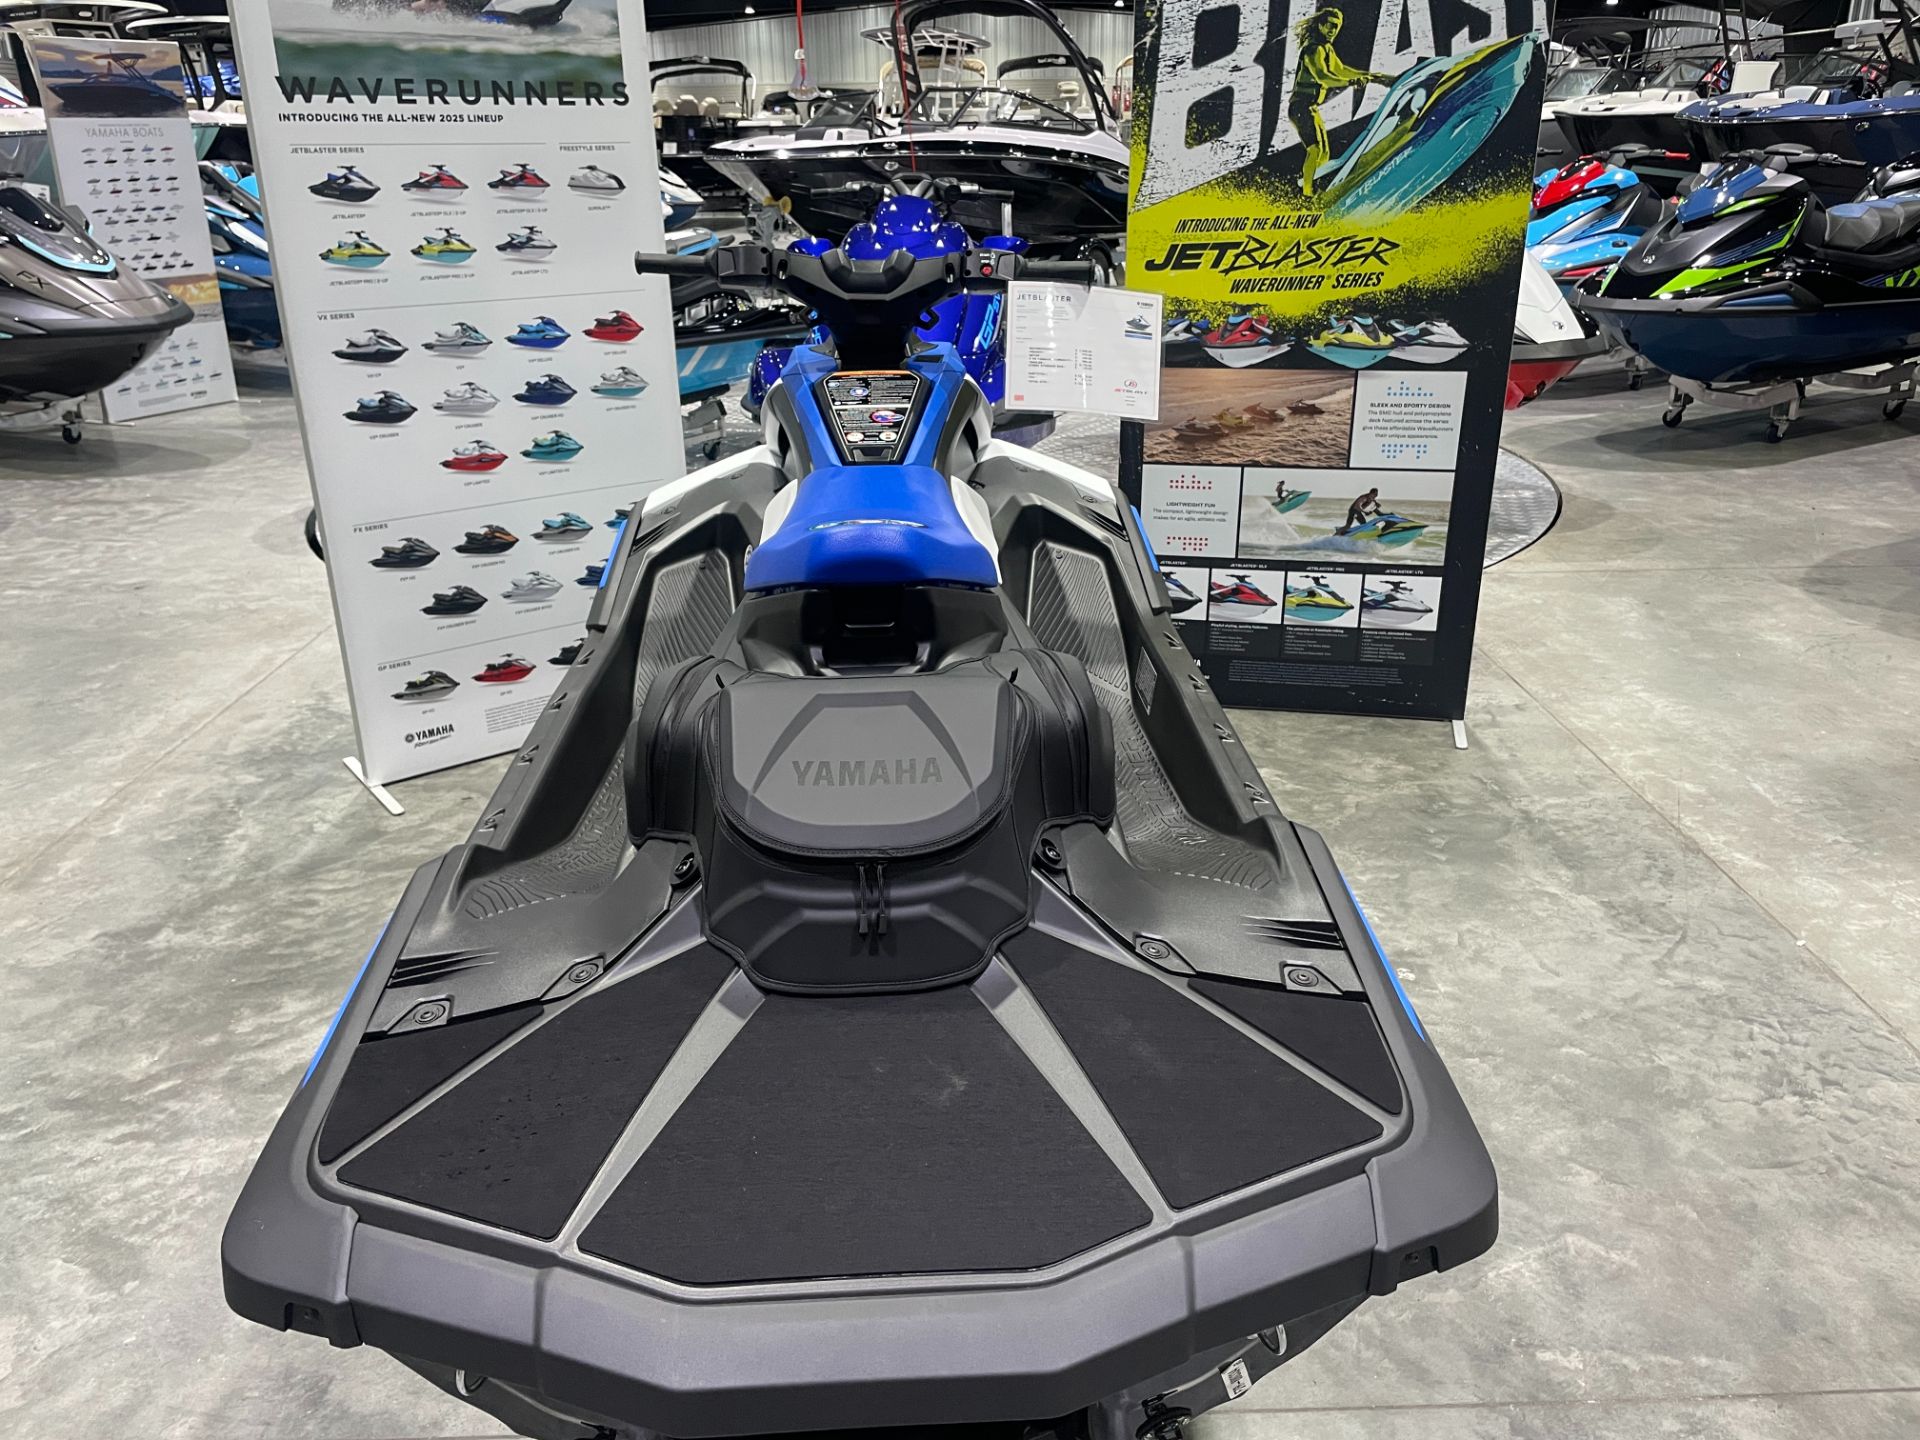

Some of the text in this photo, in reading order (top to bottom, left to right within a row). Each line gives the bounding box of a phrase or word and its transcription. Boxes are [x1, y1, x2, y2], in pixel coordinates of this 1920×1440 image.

[275, 76, 630, 106] WAVERUNNERS
[278, 113, 504, 123] INTRODUCING THE ALL-NEW 2025 LINEUP
[84, 127, 164, 138] YAMAHA BOATS
[290, 146, 365, 155] JETBLASTER SERIES
[1174, 214, 1322, 233] INTRODUCING THE ALL-NEW
[1144, 234, 1401, 276] JETBLASTER
[1332, 271, 1385, 289] SERIES
[415, 723, 455, 741] YAMAHA
[791, 756, 943, 787] YAMAHA
